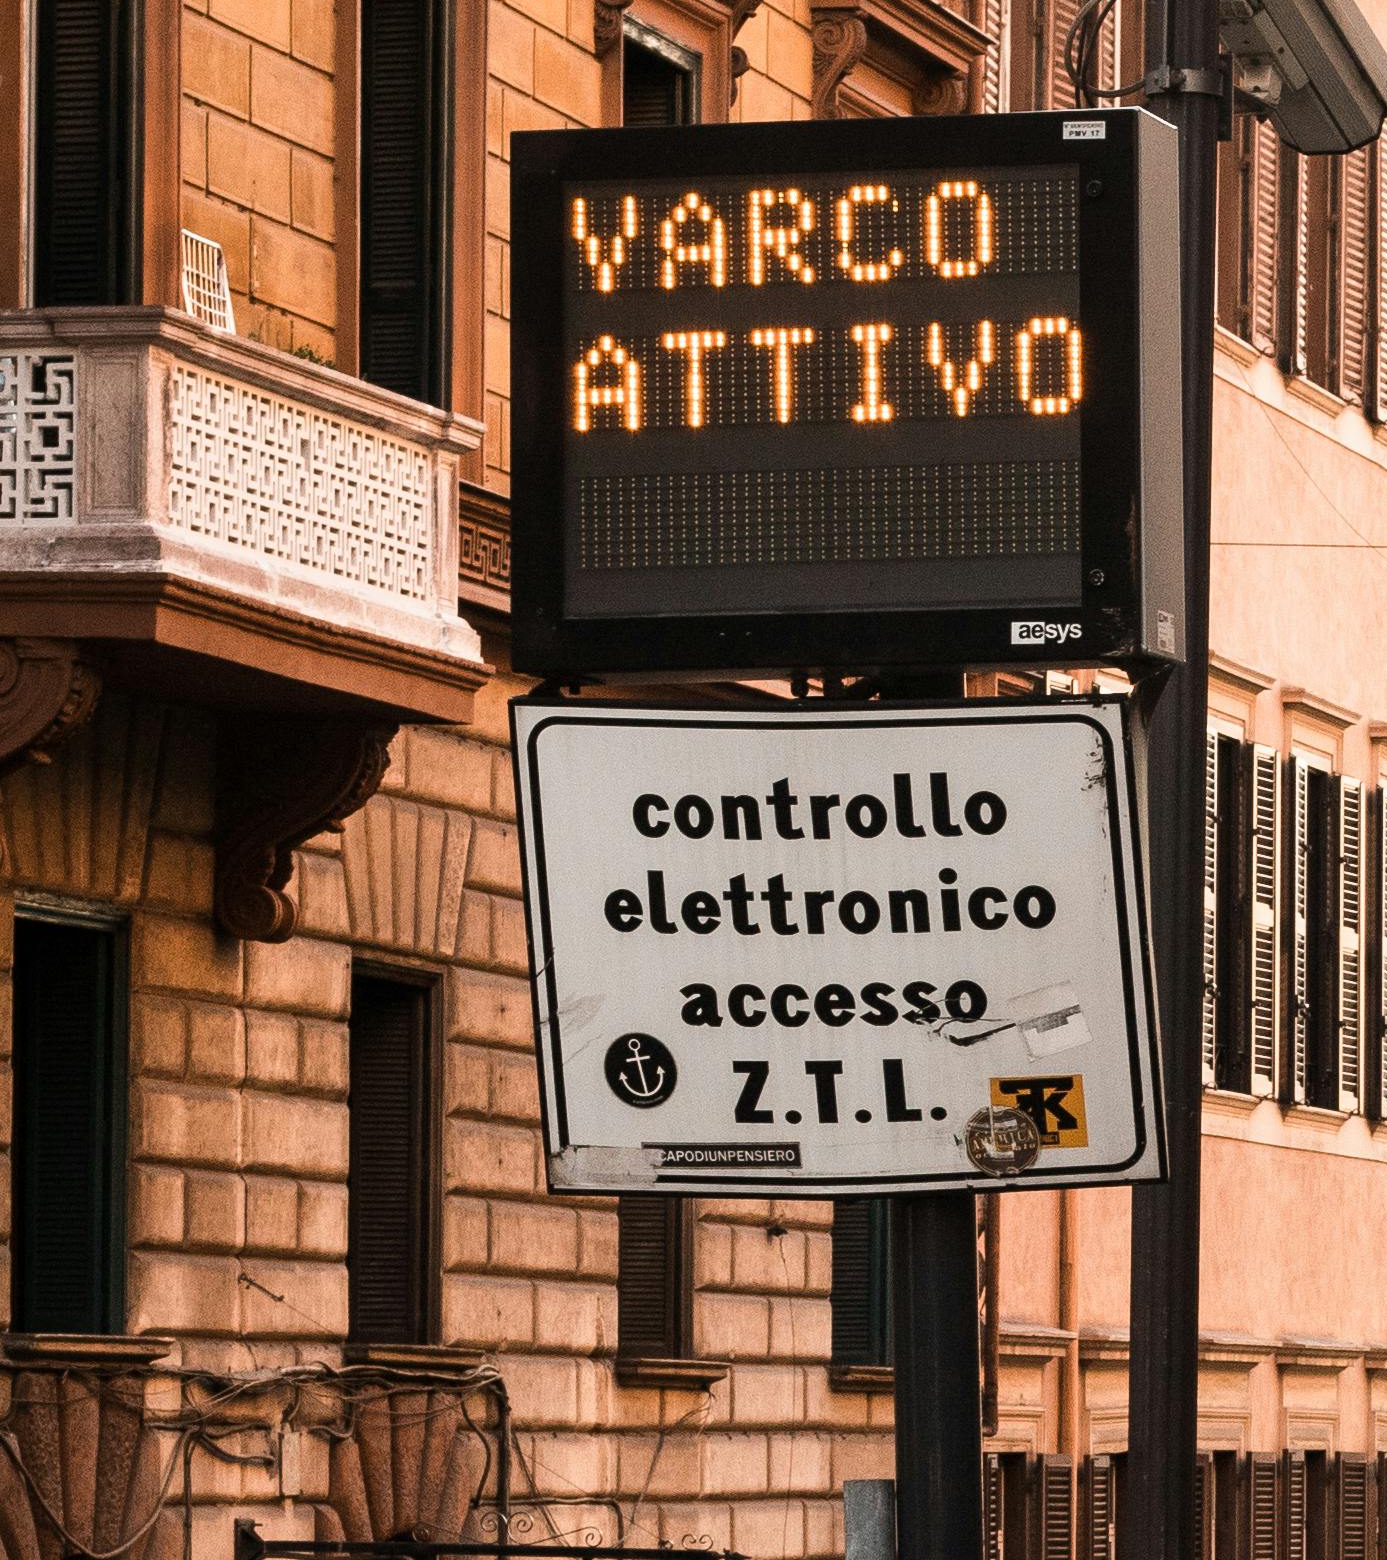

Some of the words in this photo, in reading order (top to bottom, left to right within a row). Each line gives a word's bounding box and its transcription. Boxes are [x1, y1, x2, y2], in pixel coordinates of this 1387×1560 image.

[572, 182, 994, 293] VARCO
[572, 315, 1084, 433] ATTIVO
[1018, 623, 1082, 644] aesys
[632, 771, 1008, 840] controllo
[603, 868, 1057, 936] elettronico
[679, 979, 988, 1028] accesso
[732, 1059, 948, 1125] Z.T.L.
